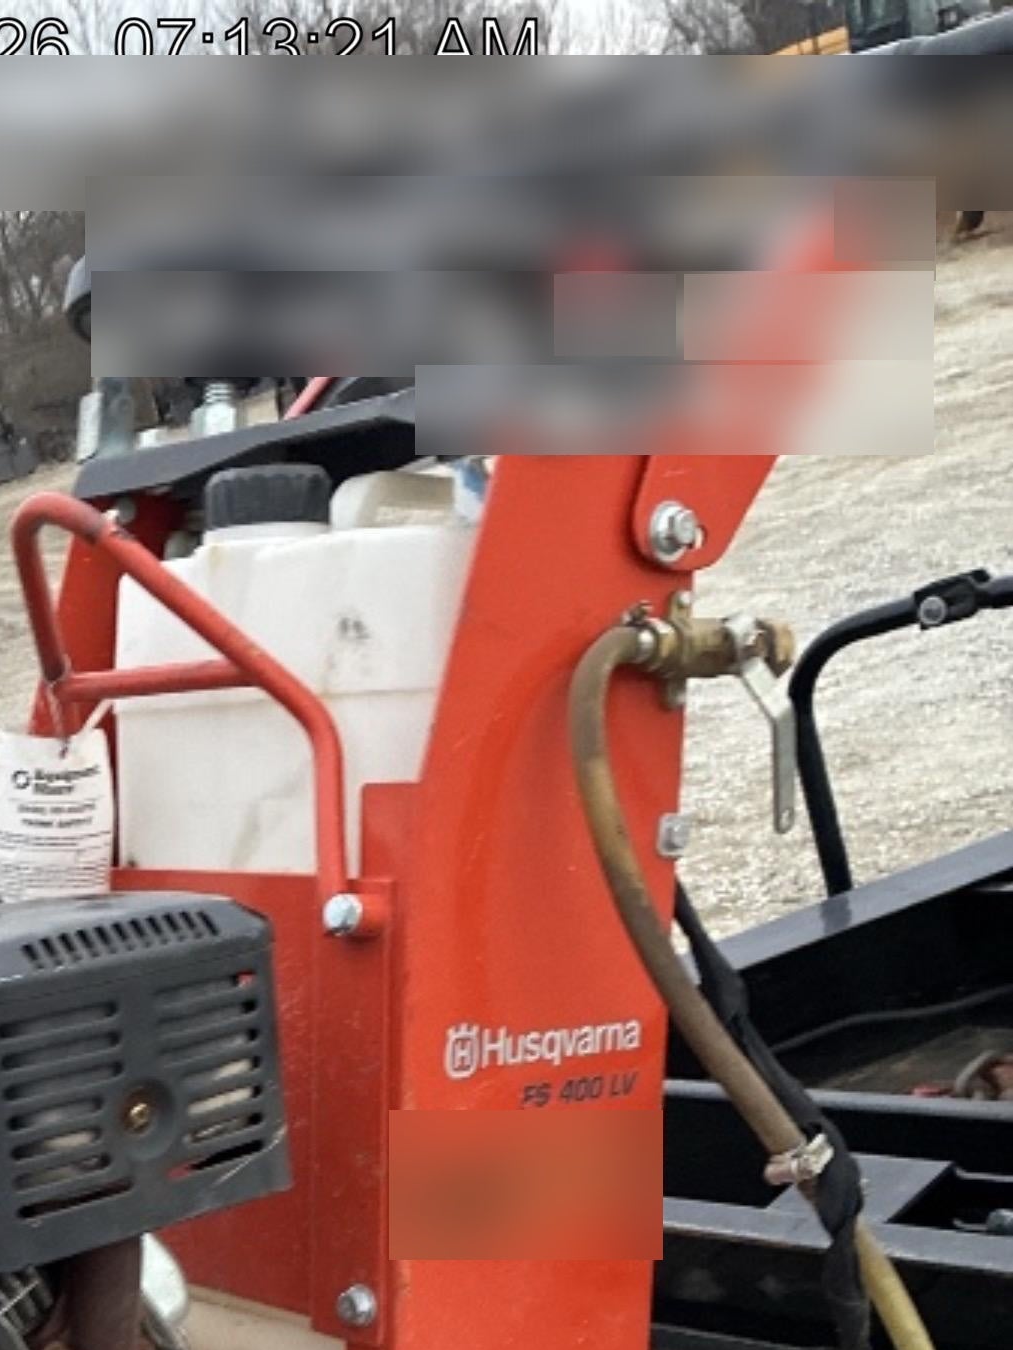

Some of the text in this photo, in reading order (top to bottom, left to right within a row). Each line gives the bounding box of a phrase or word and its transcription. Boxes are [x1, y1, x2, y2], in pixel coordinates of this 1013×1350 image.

[482, 1020, 641, 1068] Husqvarna
[523, 1073, 637, 1106] FS 400 LV
